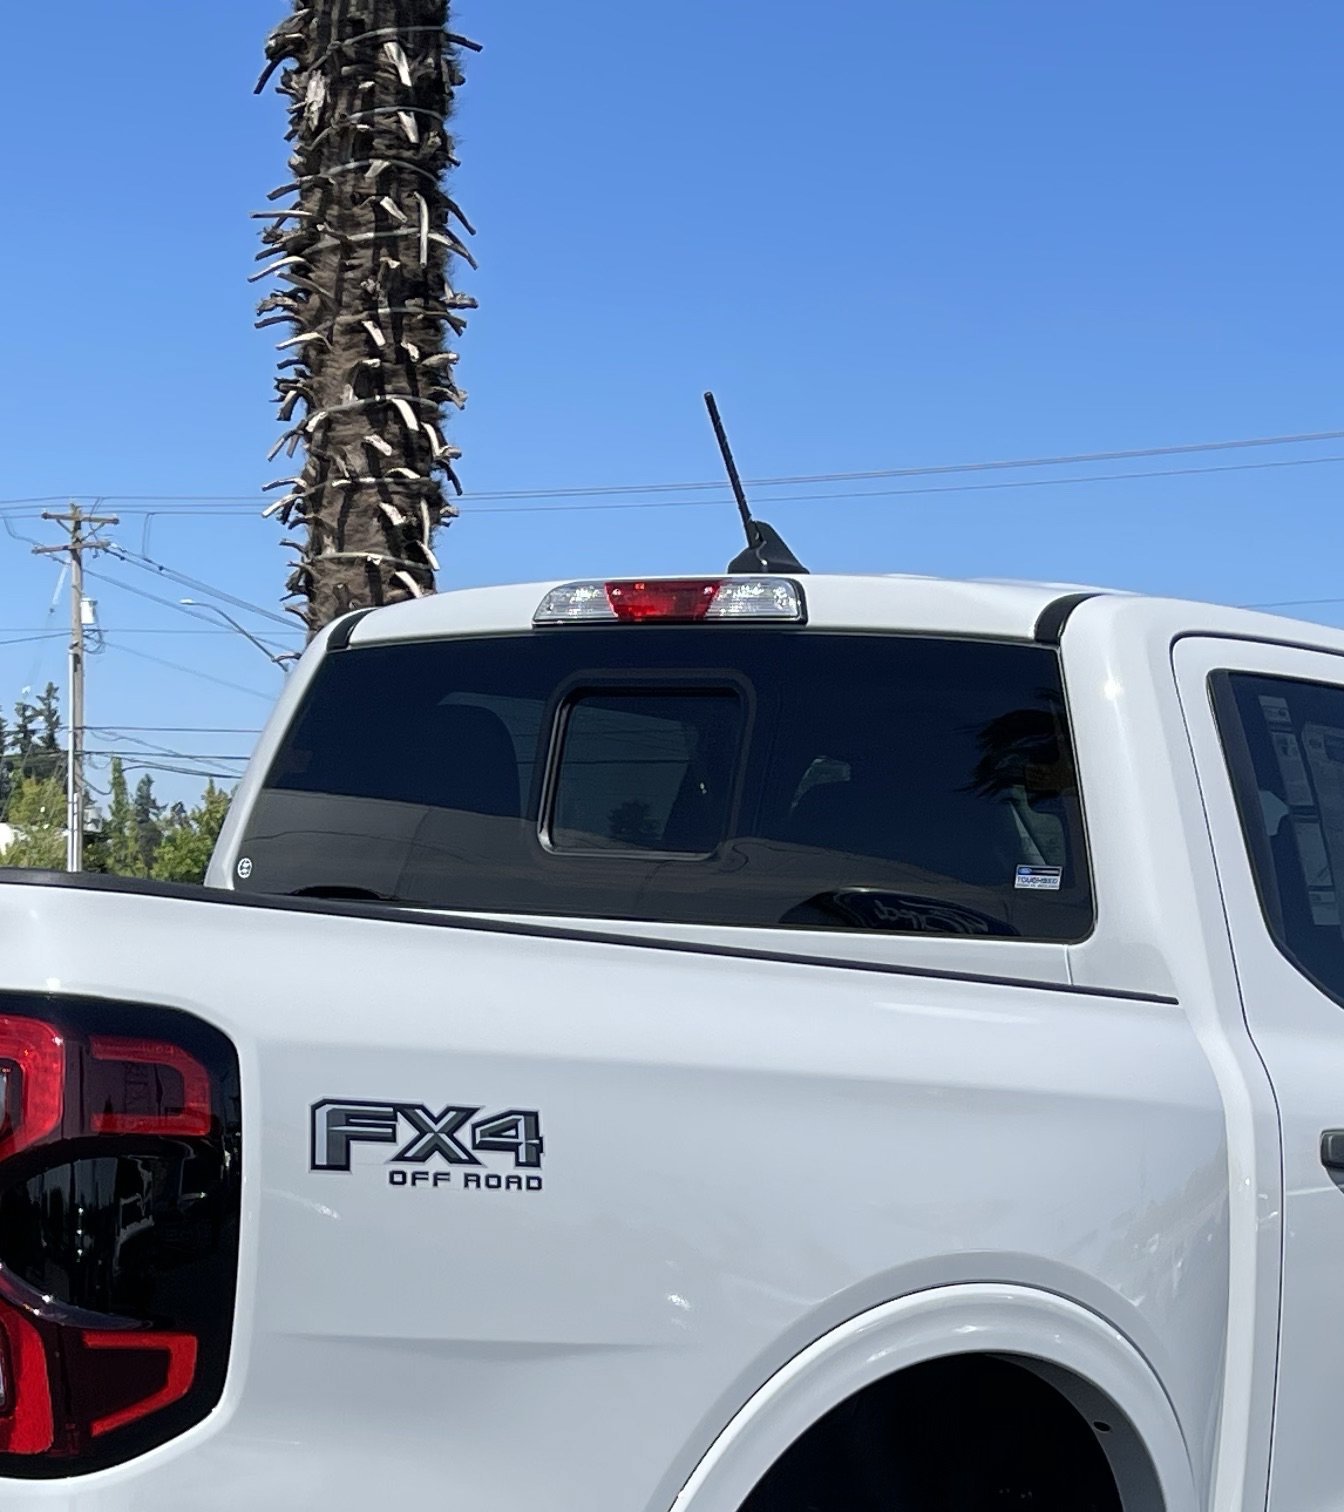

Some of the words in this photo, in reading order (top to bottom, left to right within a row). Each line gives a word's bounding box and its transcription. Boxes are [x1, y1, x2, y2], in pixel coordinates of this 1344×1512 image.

[310, 1098, 544, 1170] FX4
[388, 1170, 451, 1186] OFF
[463, 1173, 543, 1190] ROAD
